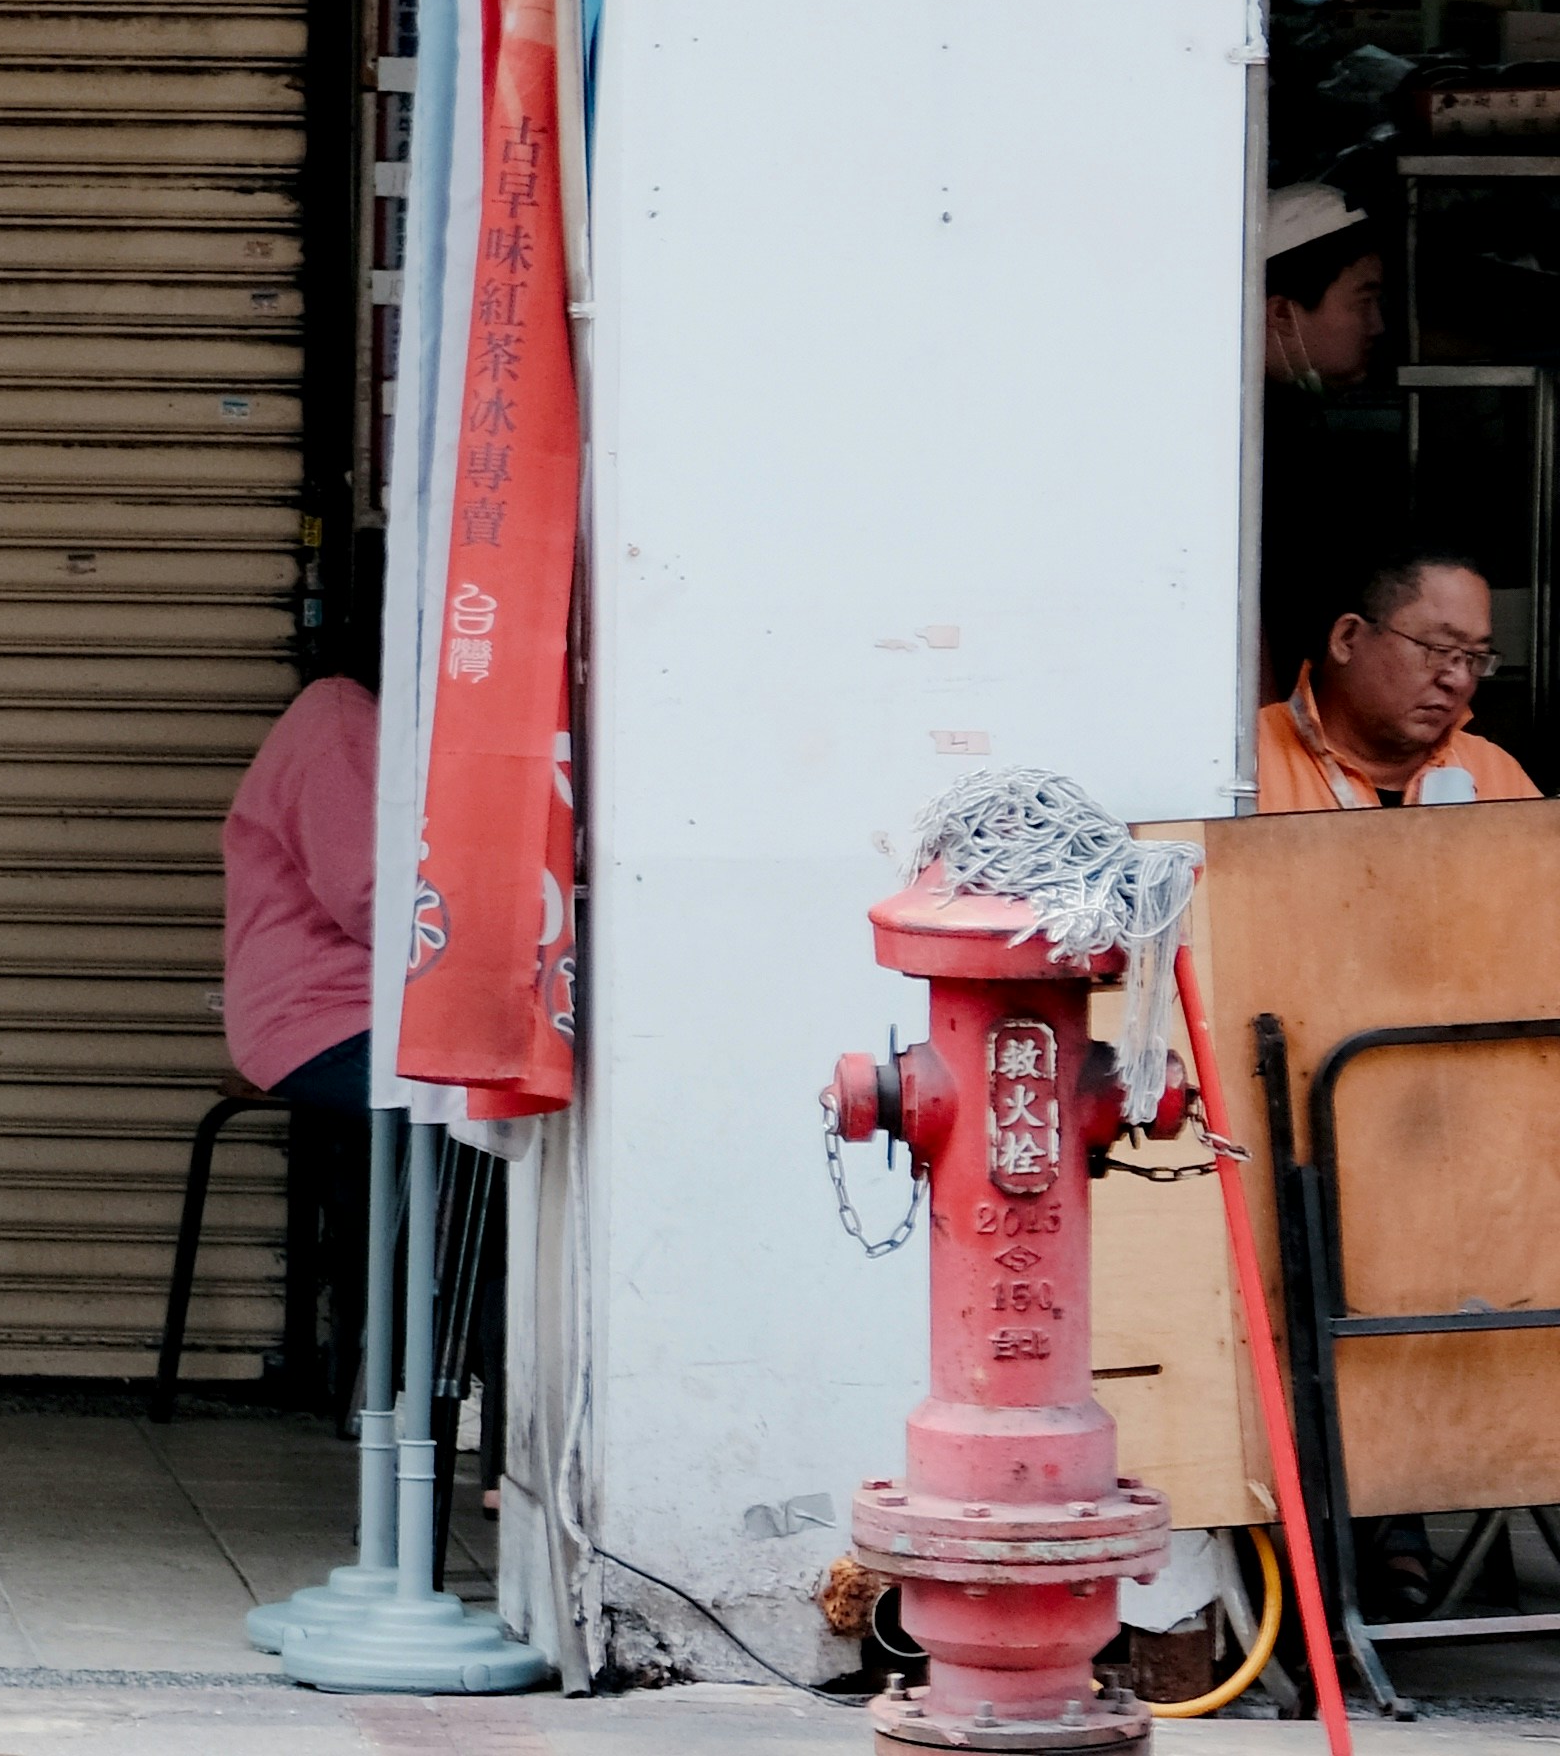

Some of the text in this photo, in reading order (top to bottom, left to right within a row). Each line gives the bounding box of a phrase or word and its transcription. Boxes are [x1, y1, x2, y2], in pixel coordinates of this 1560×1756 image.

[461, 115, 549, 547] 古早味紅茶冰專賣
[997, 1038, 1045, 1176] 救火栓
[991, 1281, 1053, 1311] 150
